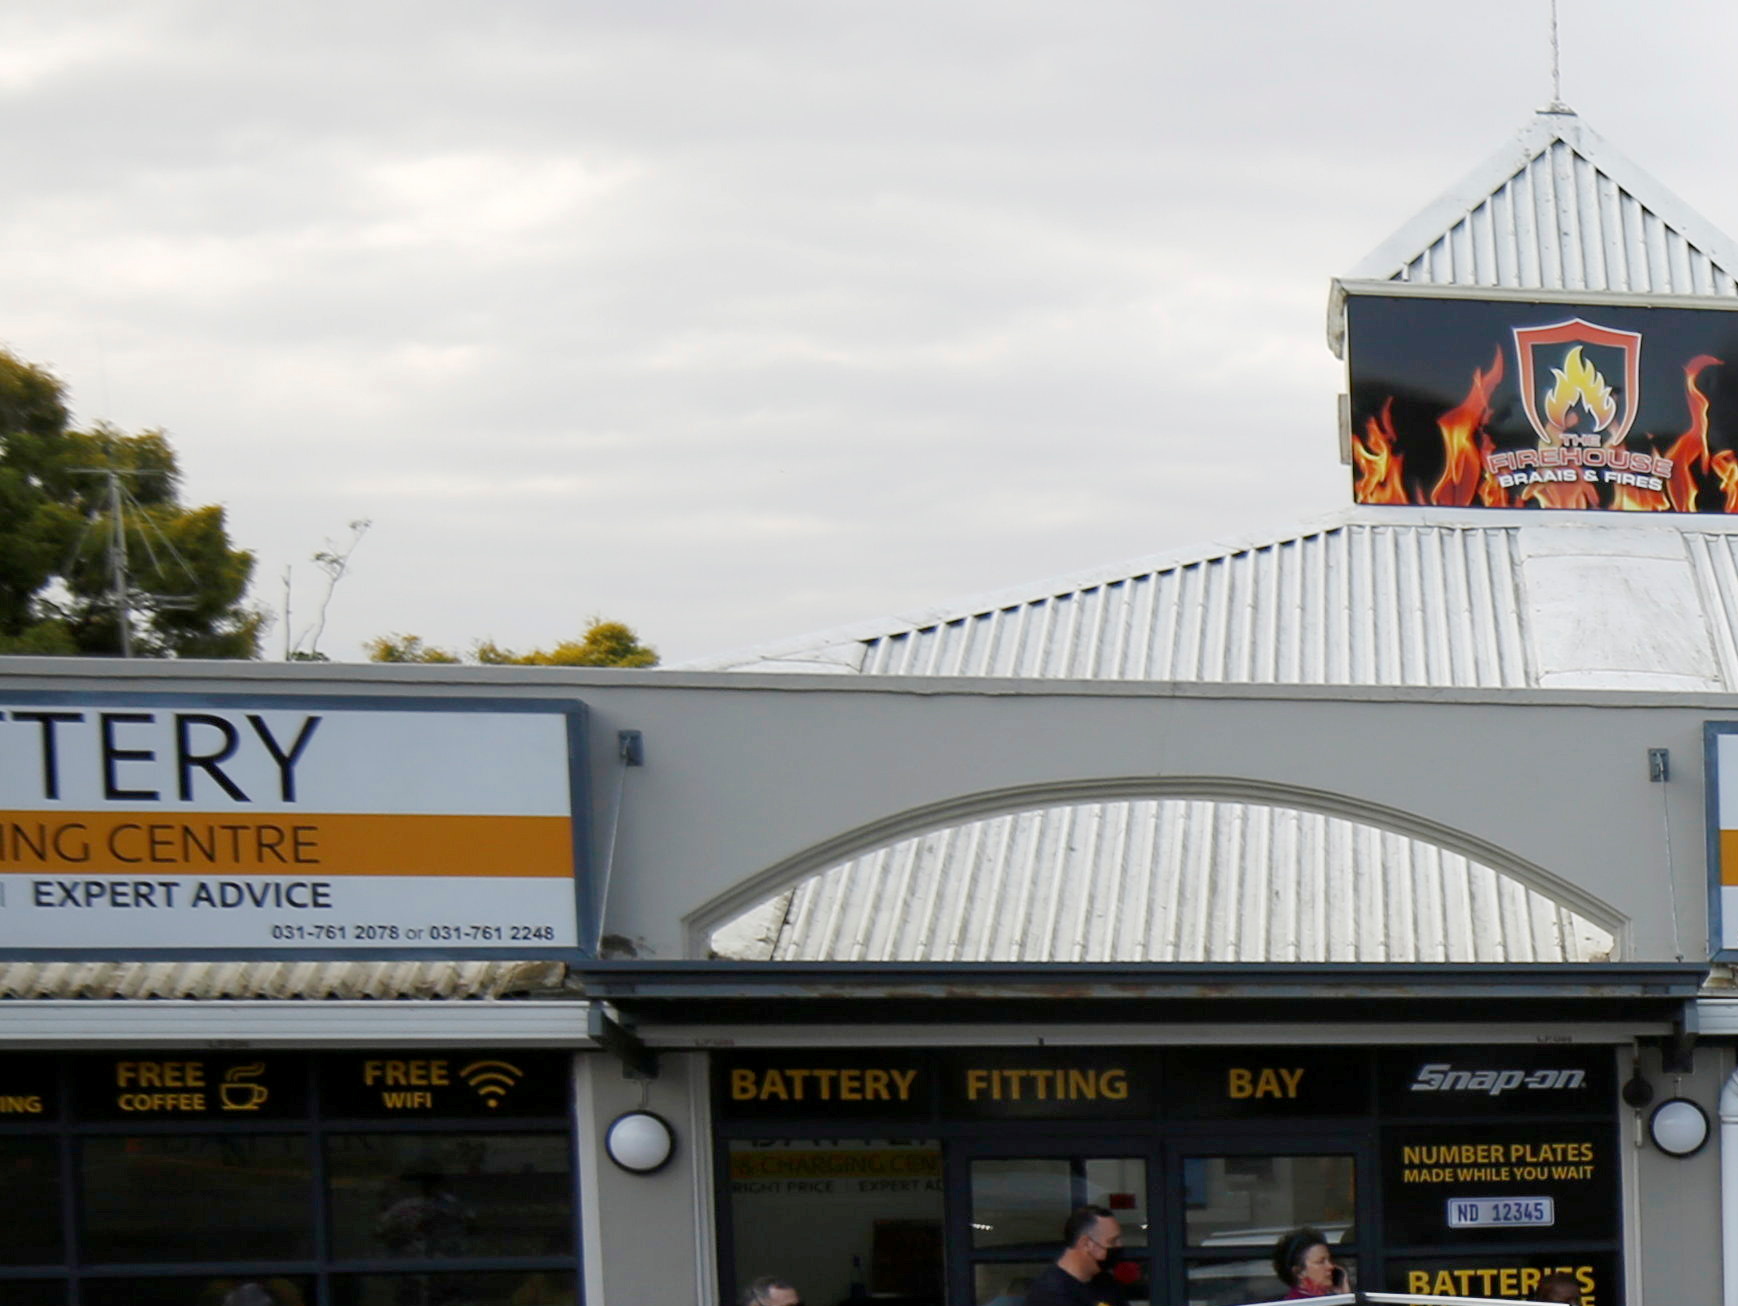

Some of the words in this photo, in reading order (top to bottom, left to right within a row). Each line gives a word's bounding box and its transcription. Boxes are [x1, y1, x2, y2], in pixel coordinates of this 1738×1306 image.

[1560, 433, 1601, 447] THE
[1488, 447, 1673, 479] FIREHOUSE
[1500, 468, 1577, 488] BRAAIS
[1584, 469, 1599, 481] &
[1604, 471, 1663, 492] FIRES
[0, 712, 322, 802] TERY
[107, 824, 320, 863] CENTRE
[33, 881, 180, 908] EXPERT
[191, 882, 332, 909] ADVICE
[272, 924, 347, 940] 031-761
[355, 924, 399, 941] 2078
[406, 927, 424, 941] or
[429, 925, 502, 941] 031-761
[510, 925, 554, 941] 2248
[116, 1062, 205, 1087] FREE
[365, 1060, 449, 1087] FREE
[731, 1069, 917, 1100] BATTERY
[967, 1069, 1128, 1100] FITTING
[1229, 1068, 1304, 1099] BAY
[1411, 1063, 1586, 1096] Snap-on
[118, 1094, 206, 1111] COFFEE
[383, 1092, 432, 1109] WIFI
[888, 1153, 940, 1174] CEN
[1404, 1144, 1504, 1165] NUMBER
[1510, 1143, 1593, 1163] PLATES
[1404, 1166, 1454, 1184] MADE
[1457, 1166, 1510, 1182] WHILE
[1513, 1166, 1548, 1182] YOU
[1551, 1165, 1594, 1181] WAIT
[1458, 1203, 1479, 1223] ND
[1491, 1202, 1544, 1222] 12345
[1408, 1266, 1596, 1296] BATTERS
